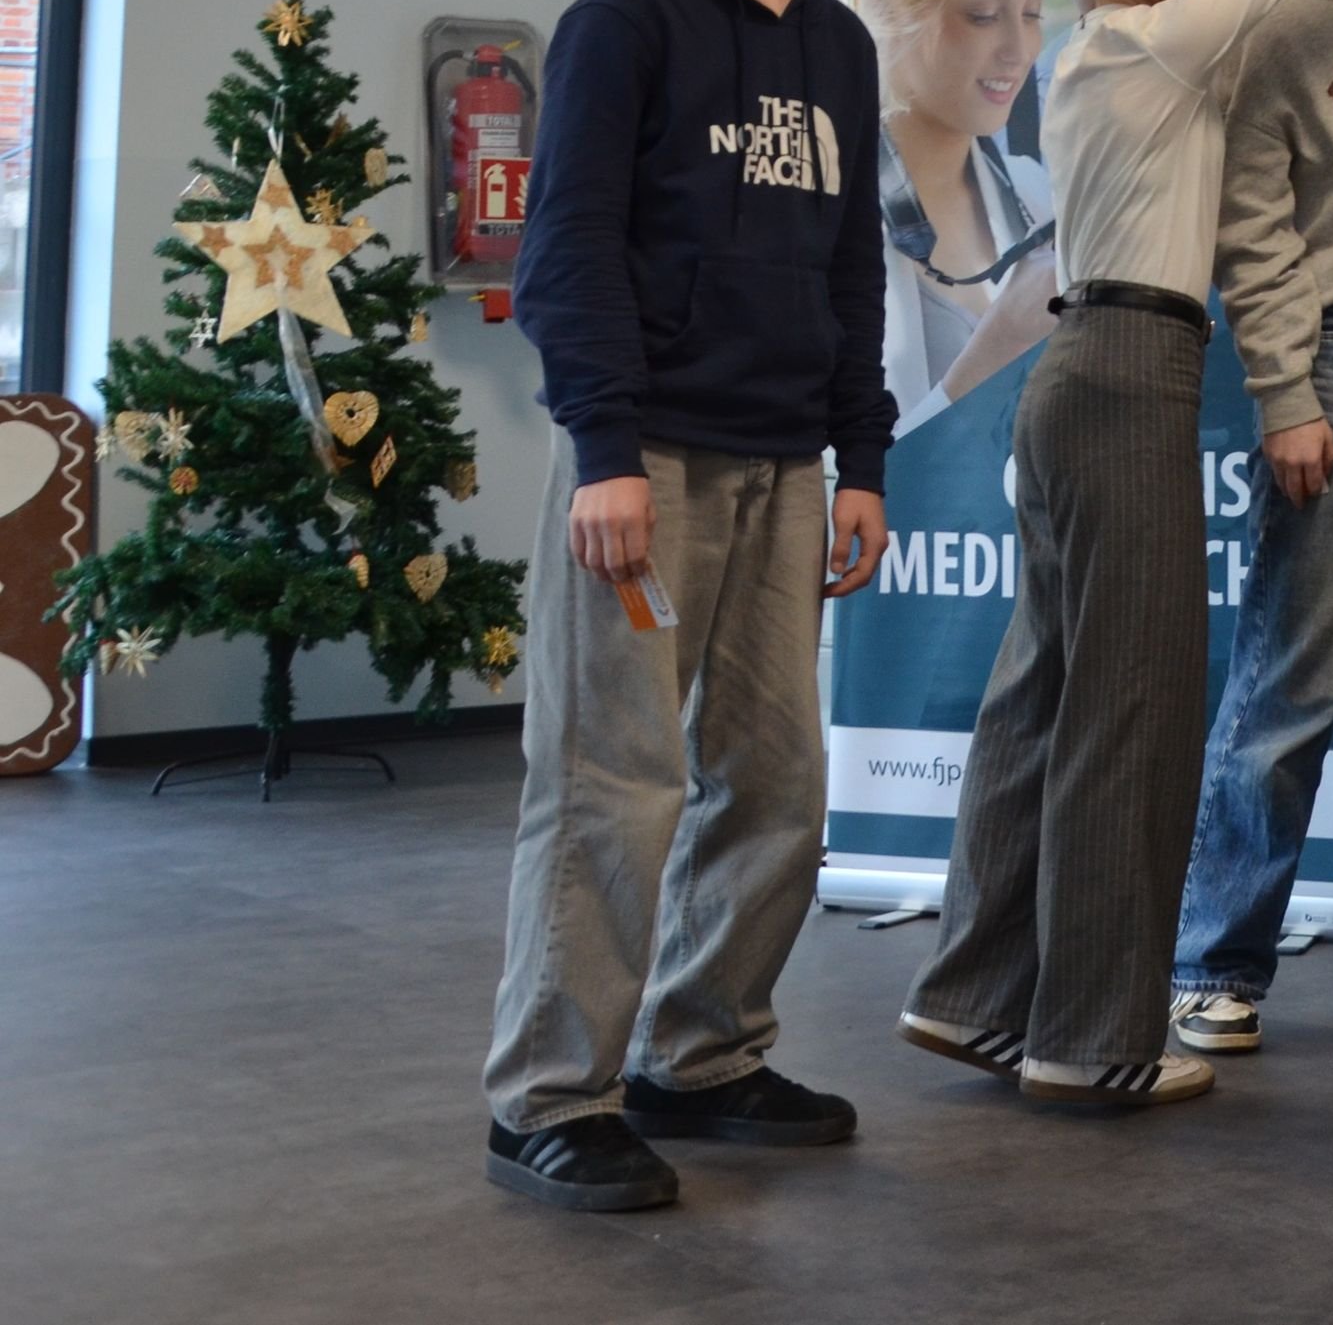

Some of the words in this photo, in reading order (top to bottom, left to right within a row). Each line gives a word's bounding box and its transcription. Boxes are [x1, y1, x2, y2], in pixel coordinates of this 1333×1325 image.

[758, 95, 804, 130] THE
[709, 122, 801, 159] NORTH
[743, 153, 802, 188] FACE
[868, 756, 962, 787] www.fjp
